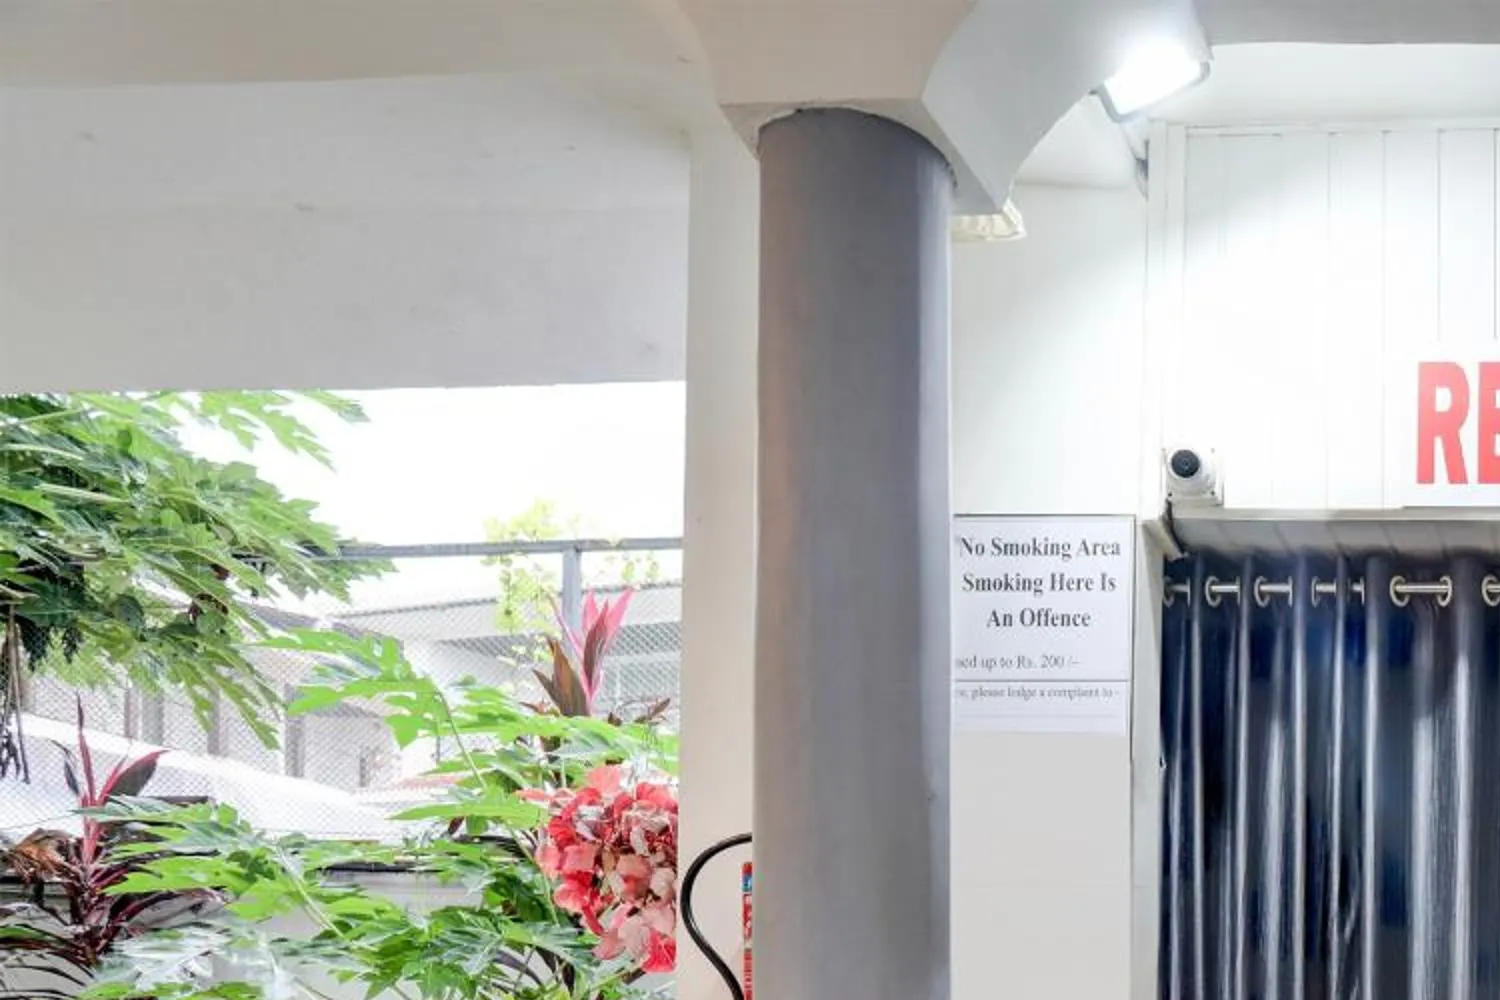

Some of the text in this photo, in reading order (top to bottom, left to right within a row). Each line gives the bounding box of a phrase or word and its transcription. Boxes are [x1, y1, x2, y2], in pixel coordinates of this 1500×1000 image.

[959, 536, 1121, 561] No Smoking Area
[962, 572, 1116, 597] Smoking Here Is
[986, 608, 1091, 628] An Offence
[981, 659, 997, 672] up
